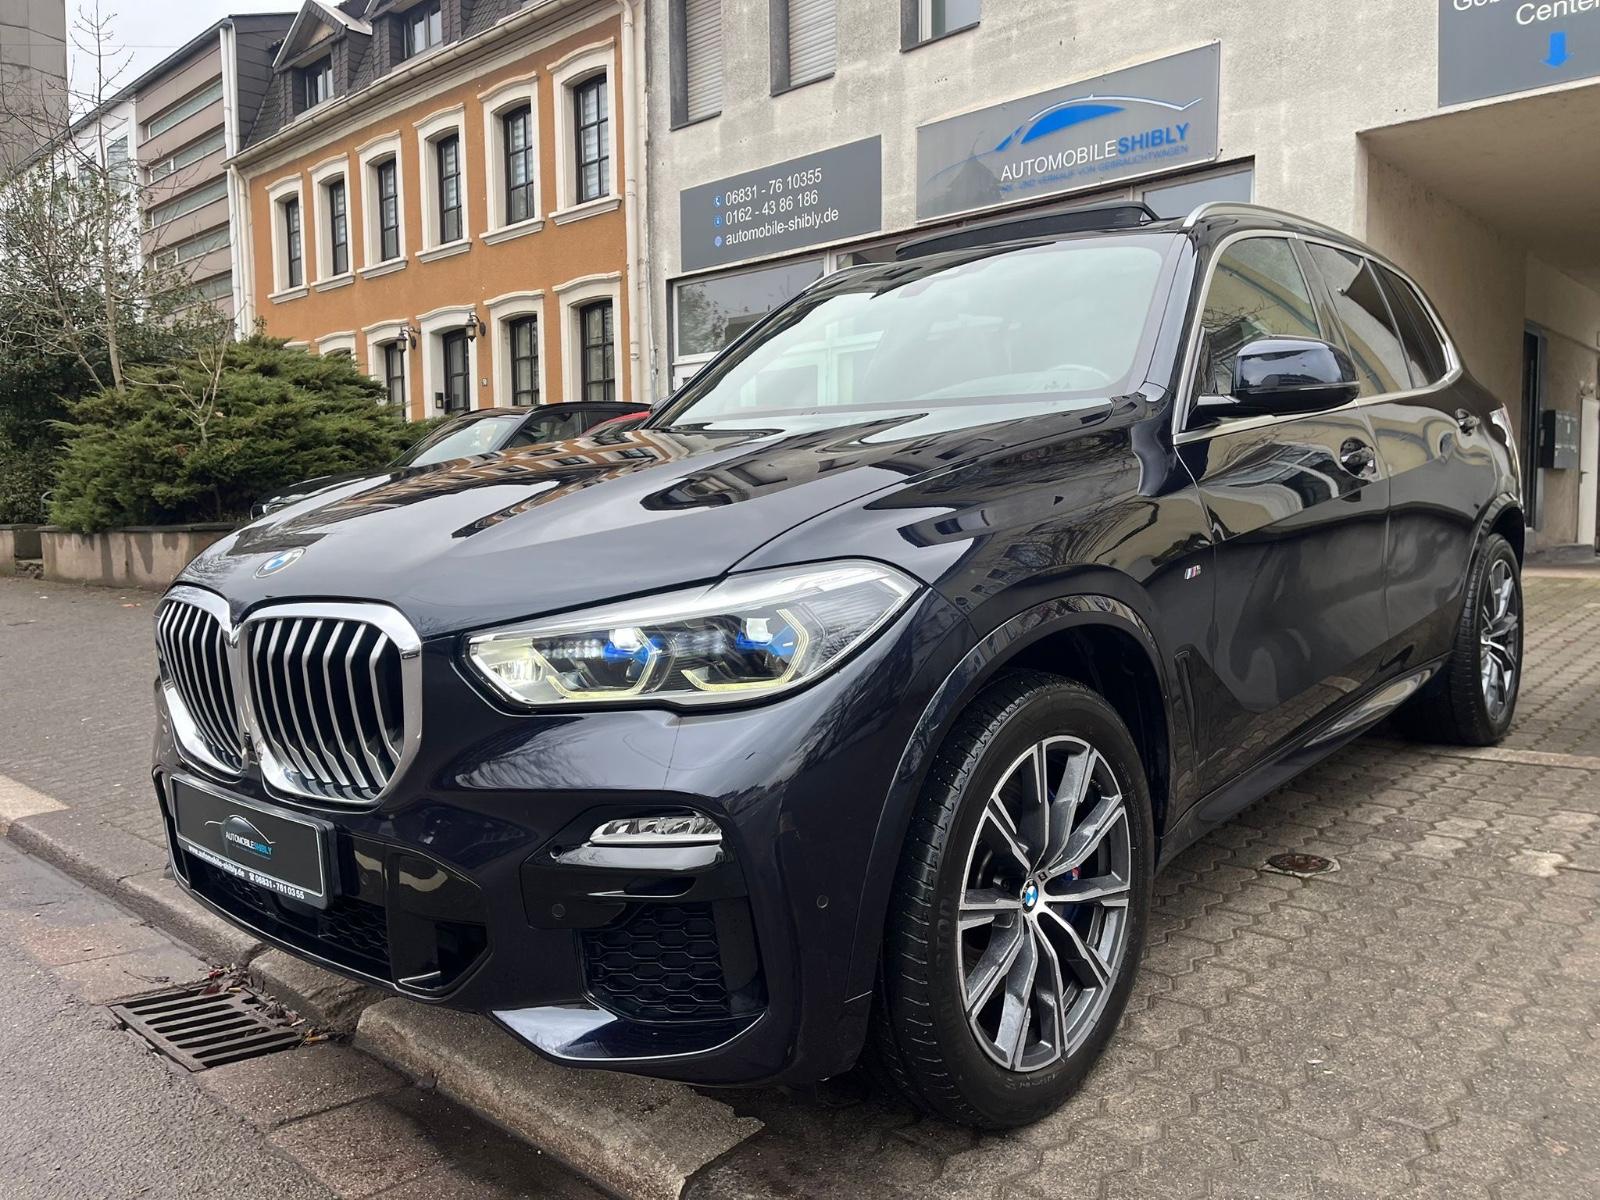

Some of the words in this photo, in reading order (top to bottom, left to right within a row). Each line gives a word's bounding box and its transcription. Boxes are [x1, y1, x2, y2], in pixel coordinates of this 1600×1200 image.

[725, 185, 757, 207] 06831
[768, 178, 783, 195] 76
[786, 167, 822, 190] 10355
[725, 206, 752, 226] 0162
[761, 200, 776, 216] 43
[779, 195, 793, 212] 86
[797, 189, 818, 208] 186
[725, 207, 839, 245] automobile-shibly.de
